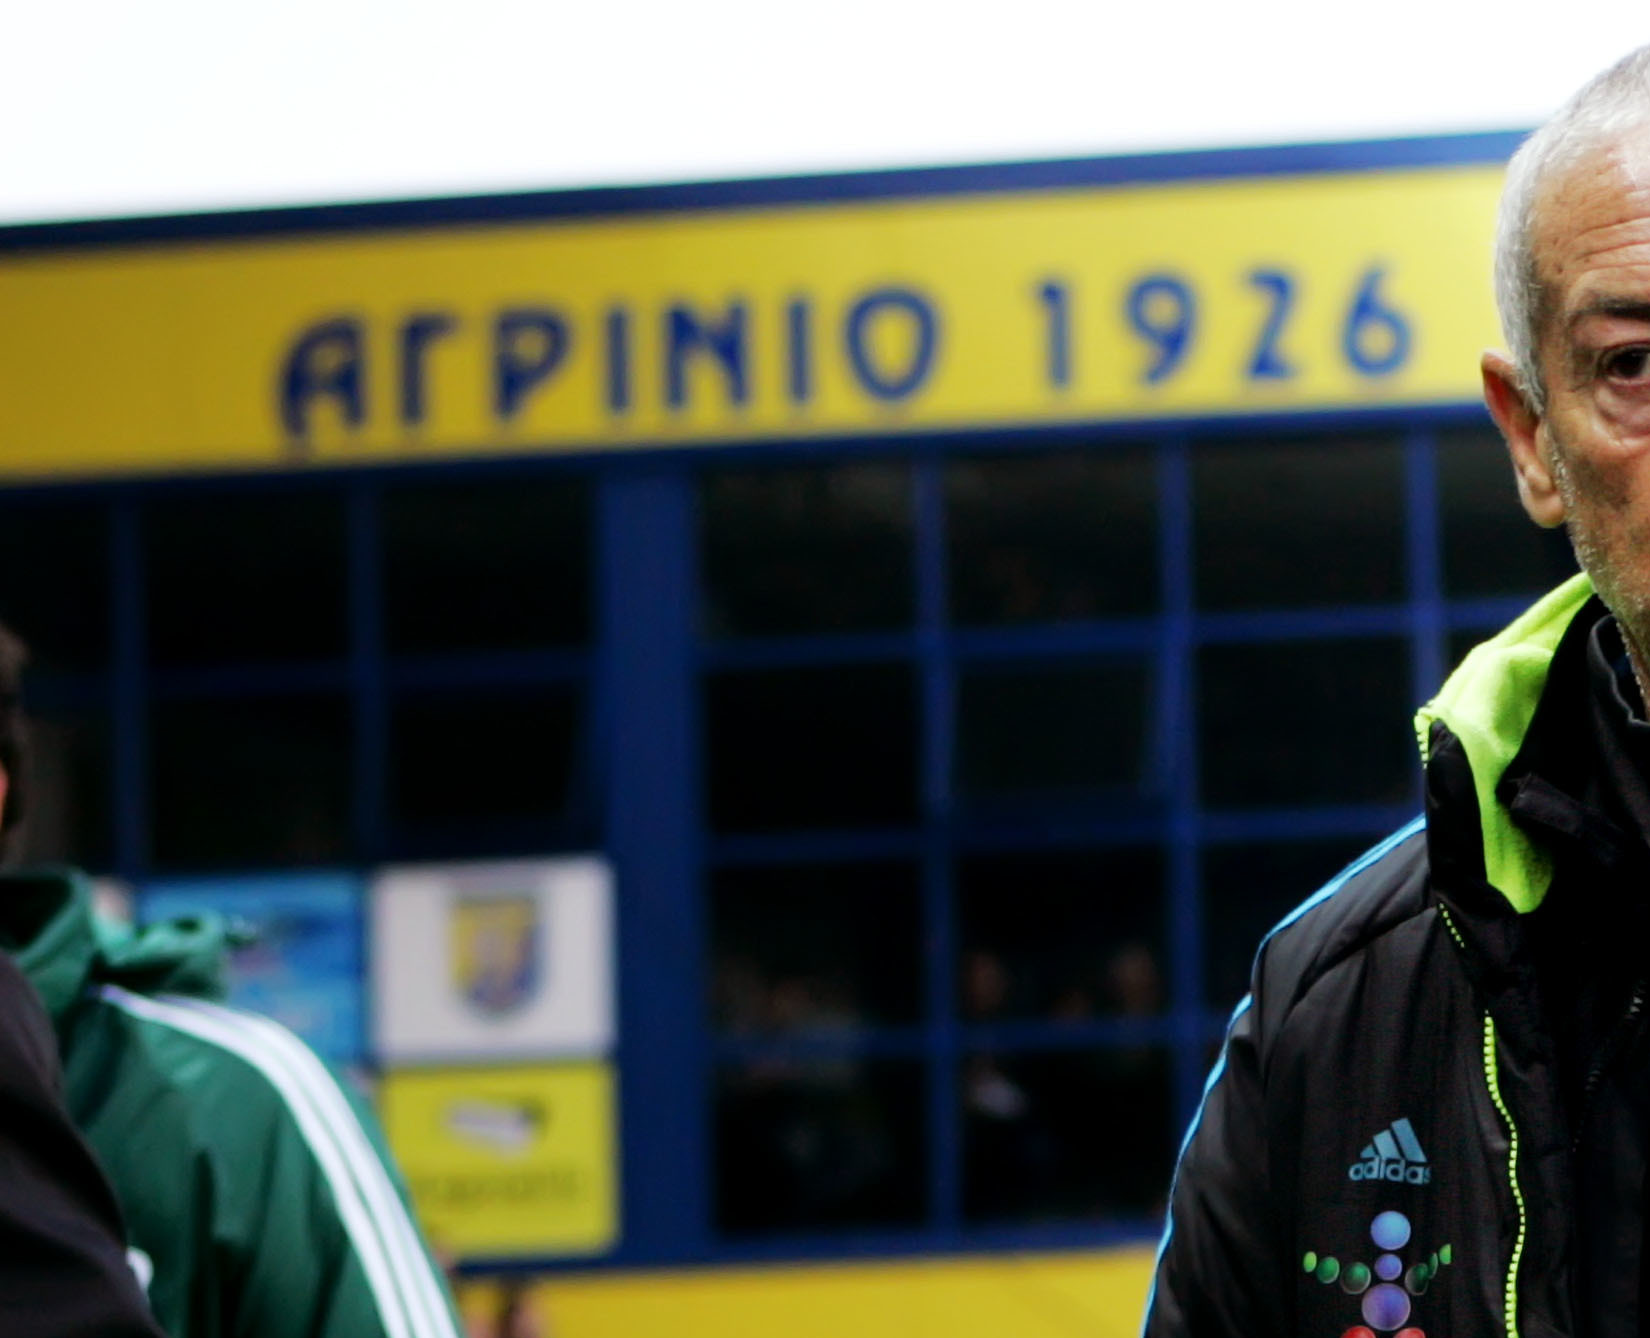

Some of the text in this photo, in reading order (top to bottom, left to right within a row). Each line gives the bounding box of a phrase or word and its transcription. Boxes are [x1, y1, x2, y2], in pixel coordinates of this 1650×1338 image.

[278, 262, 1414, 440] ΑΓΡΙΝΙΟ 1926
[1348, 1155, 1432, 1185] adidas
